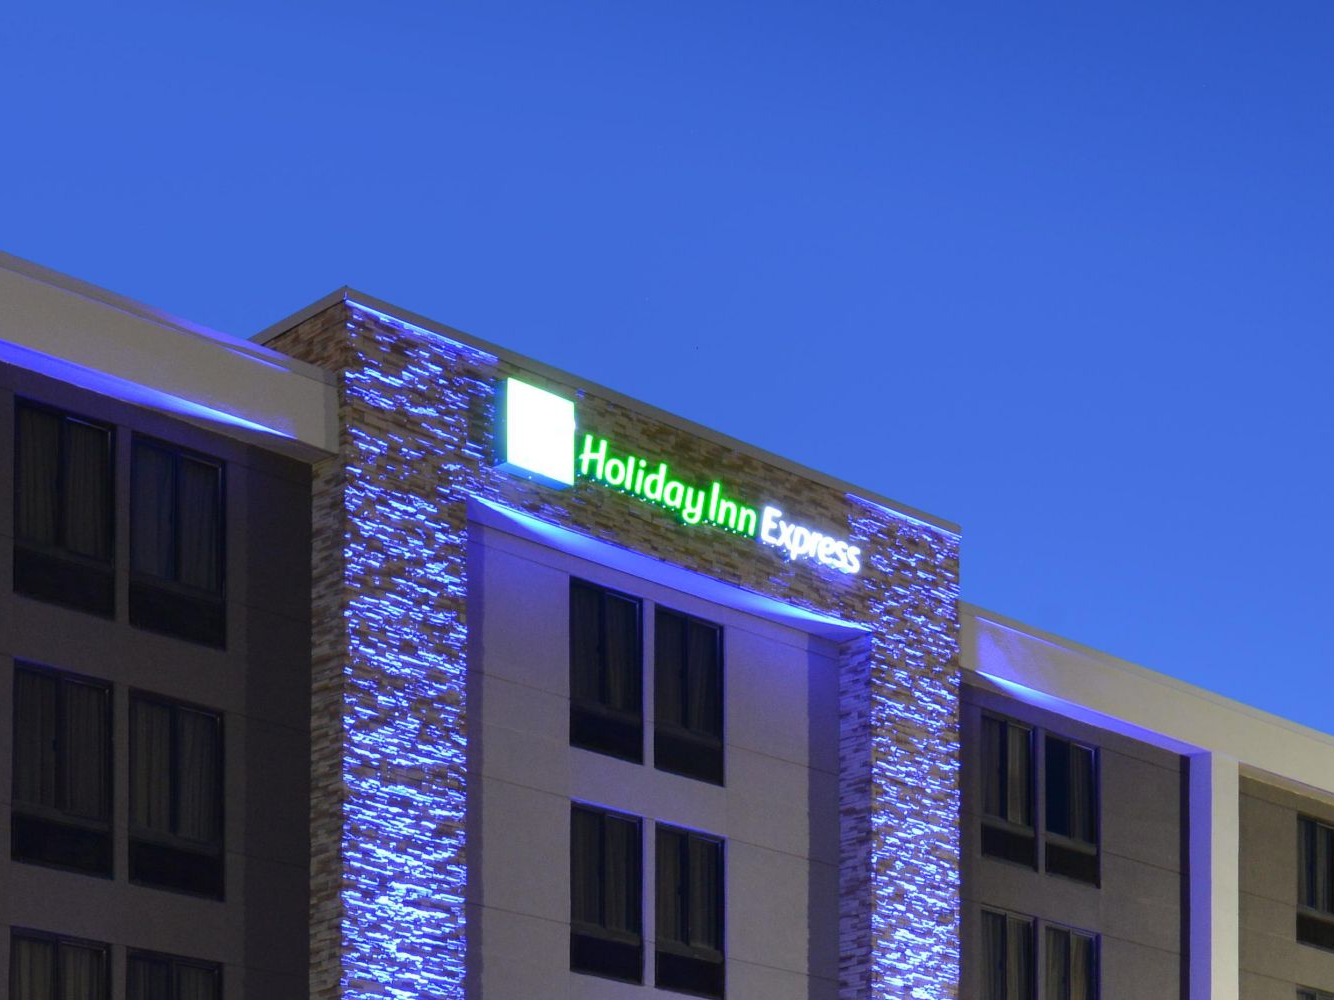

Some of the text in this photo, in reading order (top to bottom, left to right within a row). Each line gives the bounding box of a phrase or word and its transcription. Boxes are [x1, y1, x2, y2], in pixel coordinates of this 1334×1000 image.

[578, 433, 861, 574] Holiday Inn Express
